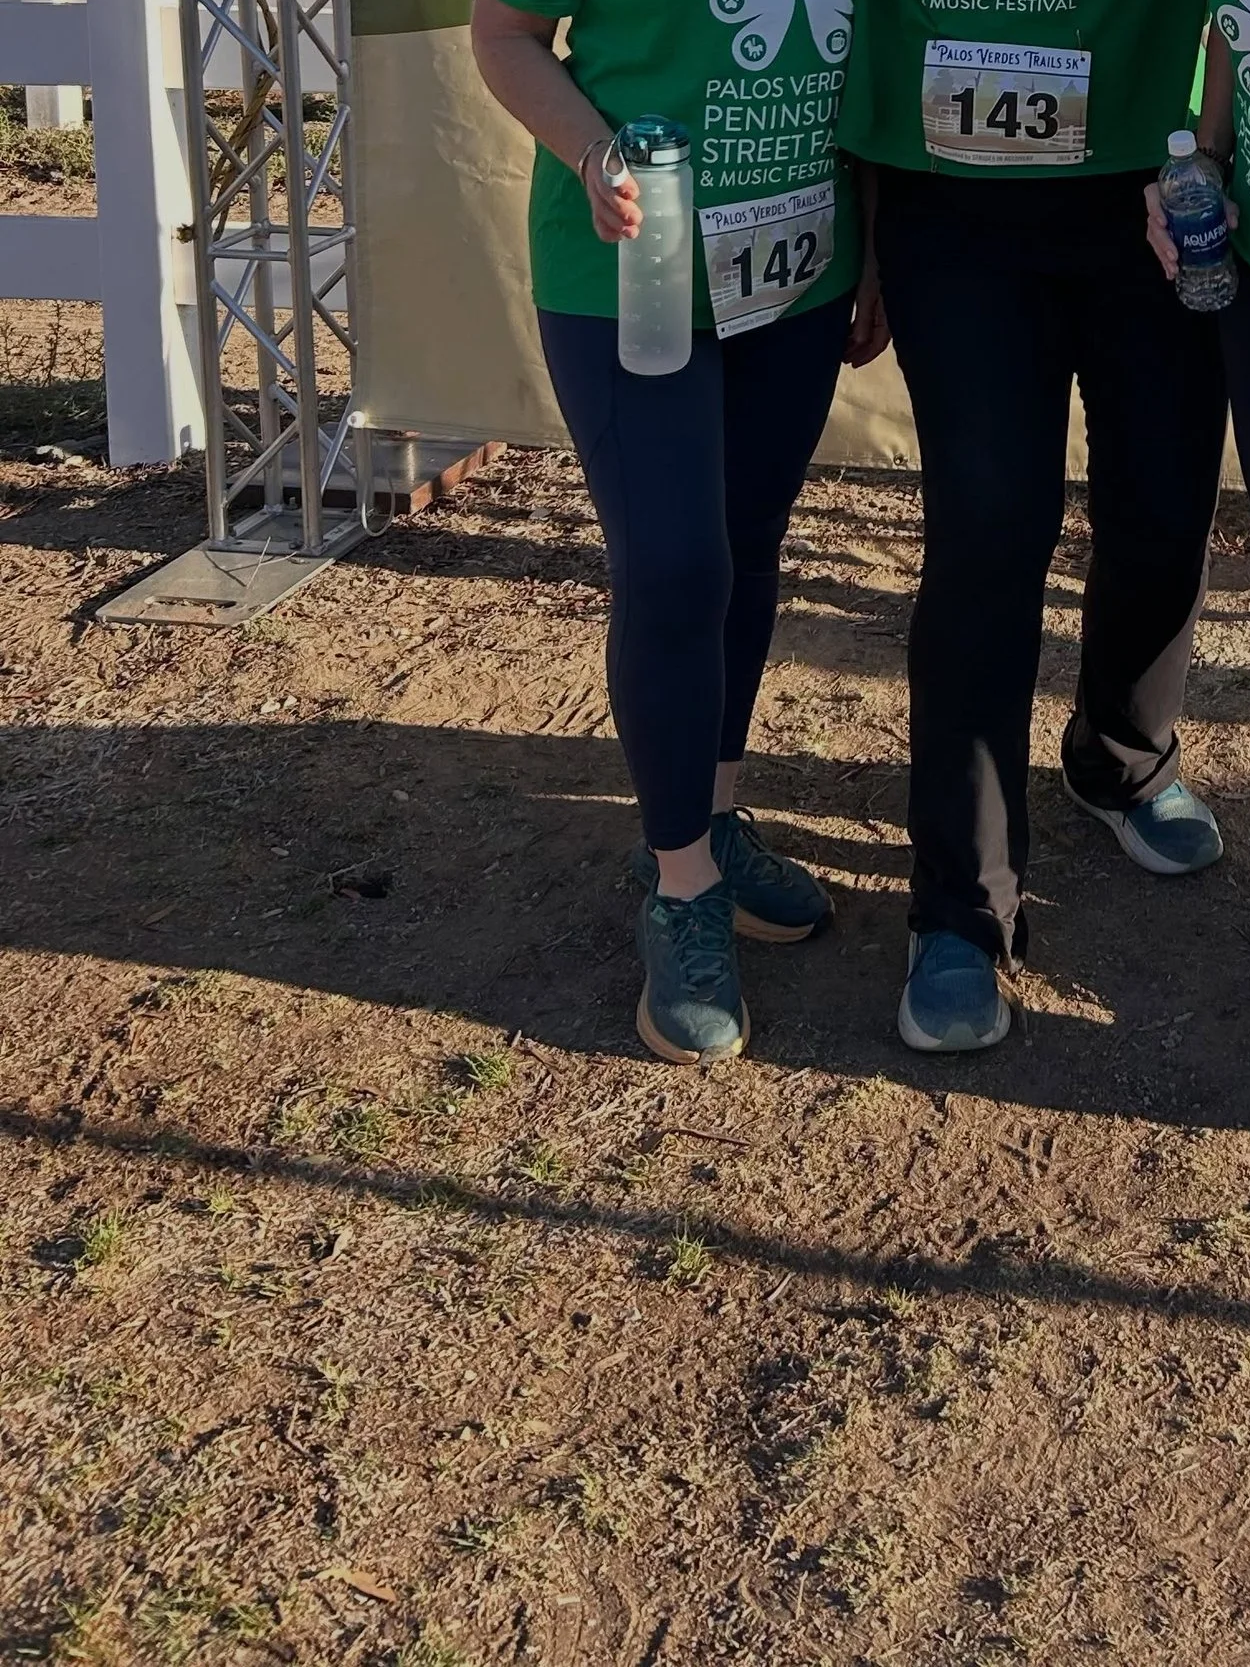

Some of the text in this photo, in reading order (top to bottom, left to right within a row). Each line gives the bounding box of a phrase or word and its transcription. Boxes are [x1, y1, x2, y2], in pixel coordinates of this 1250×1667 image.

[936, 44, 1079, 70] PALOS VERDES TRAILS 5K
[706, 70, 846, 100] PALOS VERD
[704, 96, 840, 132] PENINSUL
[951, 87, 1058, 139] 143
[701, 127, 838, 164] STREET FA
[700, 158, 835, 187] & MUSIC FESTI
[712, 211, 748, 230] PALOS
[750, 202, 787, 222] VERDES
[788, 193, 817, 213] TRAILS
[1184, 220, 1228, 247] AQUAFIN
[732, 231, 818, 298] 142
